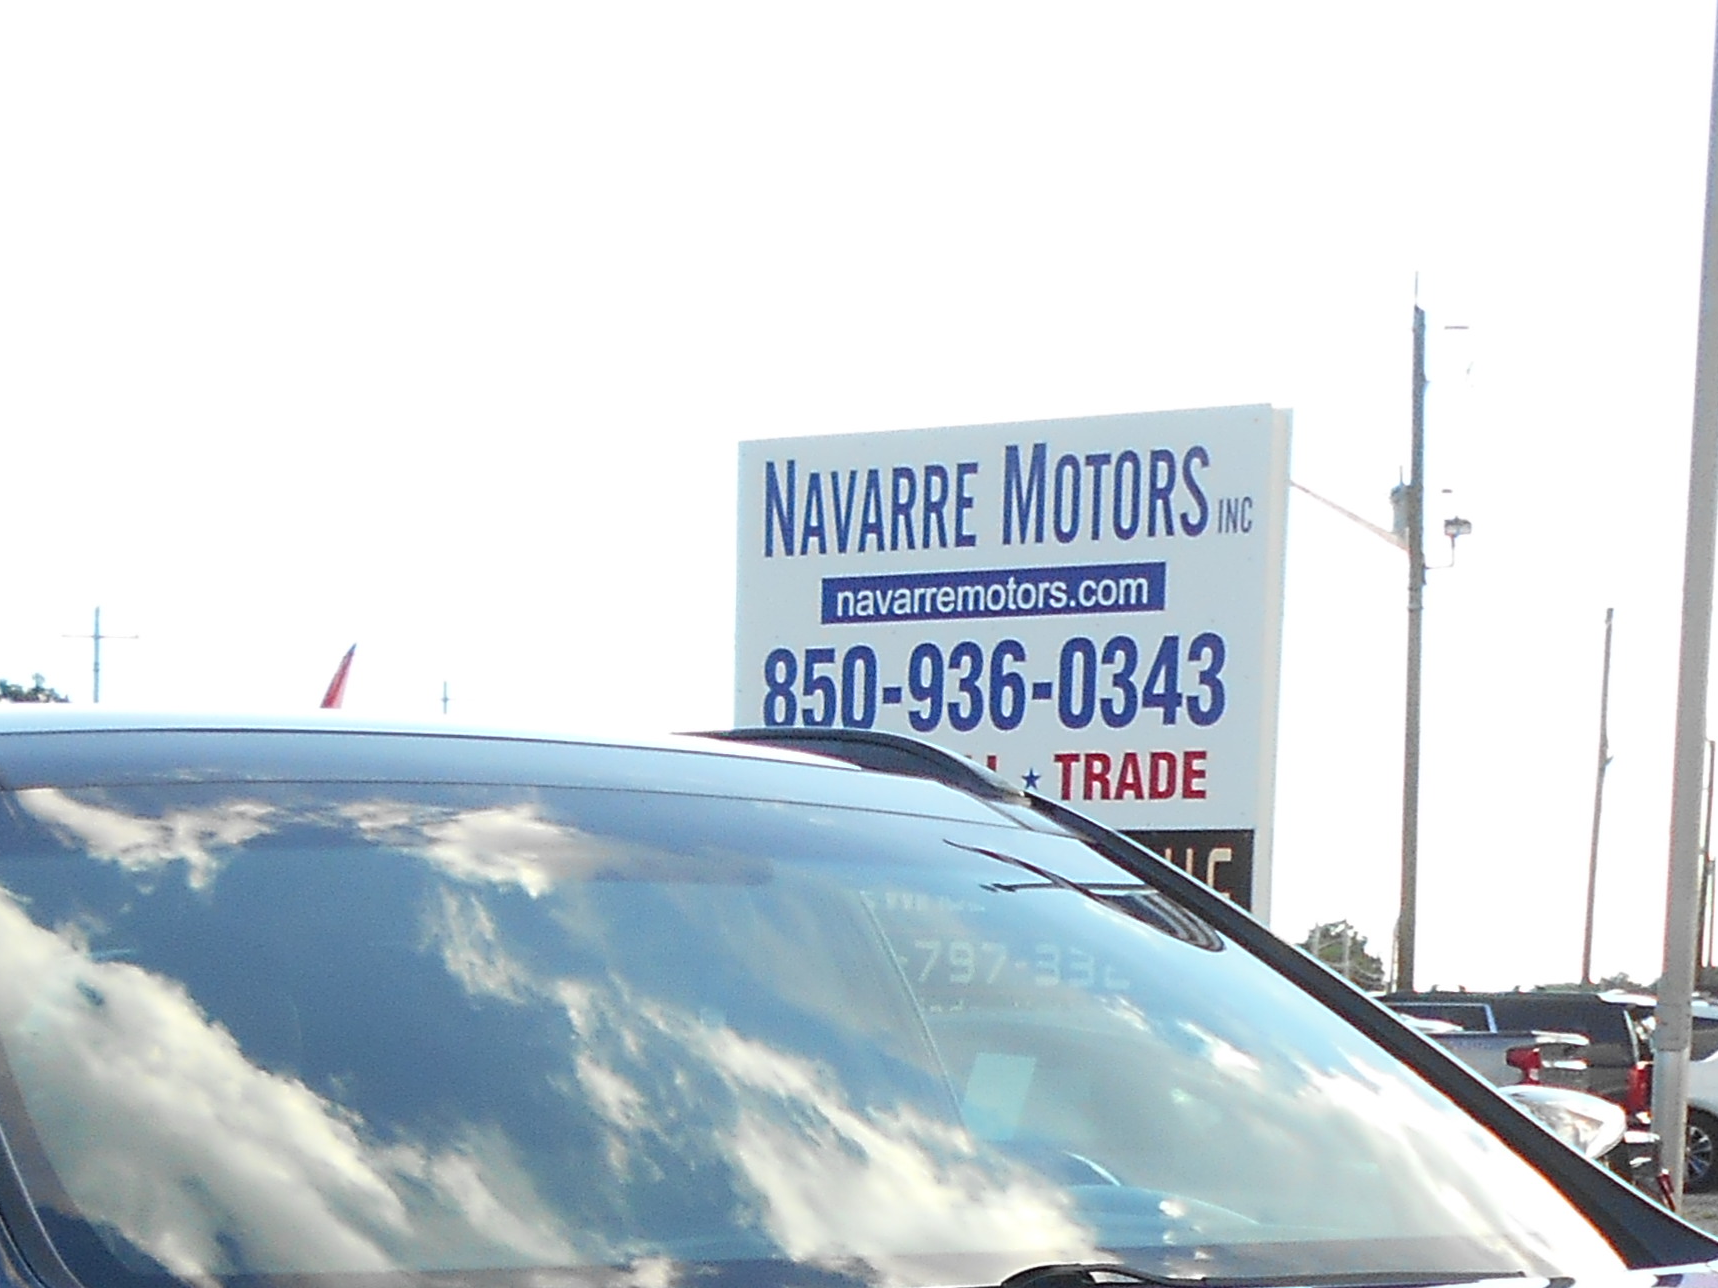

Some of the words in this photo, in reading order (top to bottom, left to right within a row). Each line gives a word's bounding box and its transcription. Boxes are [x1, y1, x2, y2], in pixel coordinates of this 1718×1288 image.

[764, 459, 979, 558] NAVARRE
[1001, 442, 1210, 545] MOTORS
[1217, 496, 1253, 534] INC
[836, 575, 1148, 617] navarremotors.com
[762, 631, 1228, 733] 850-936-0343
[1052, 750, 1208, 802] TRADE
